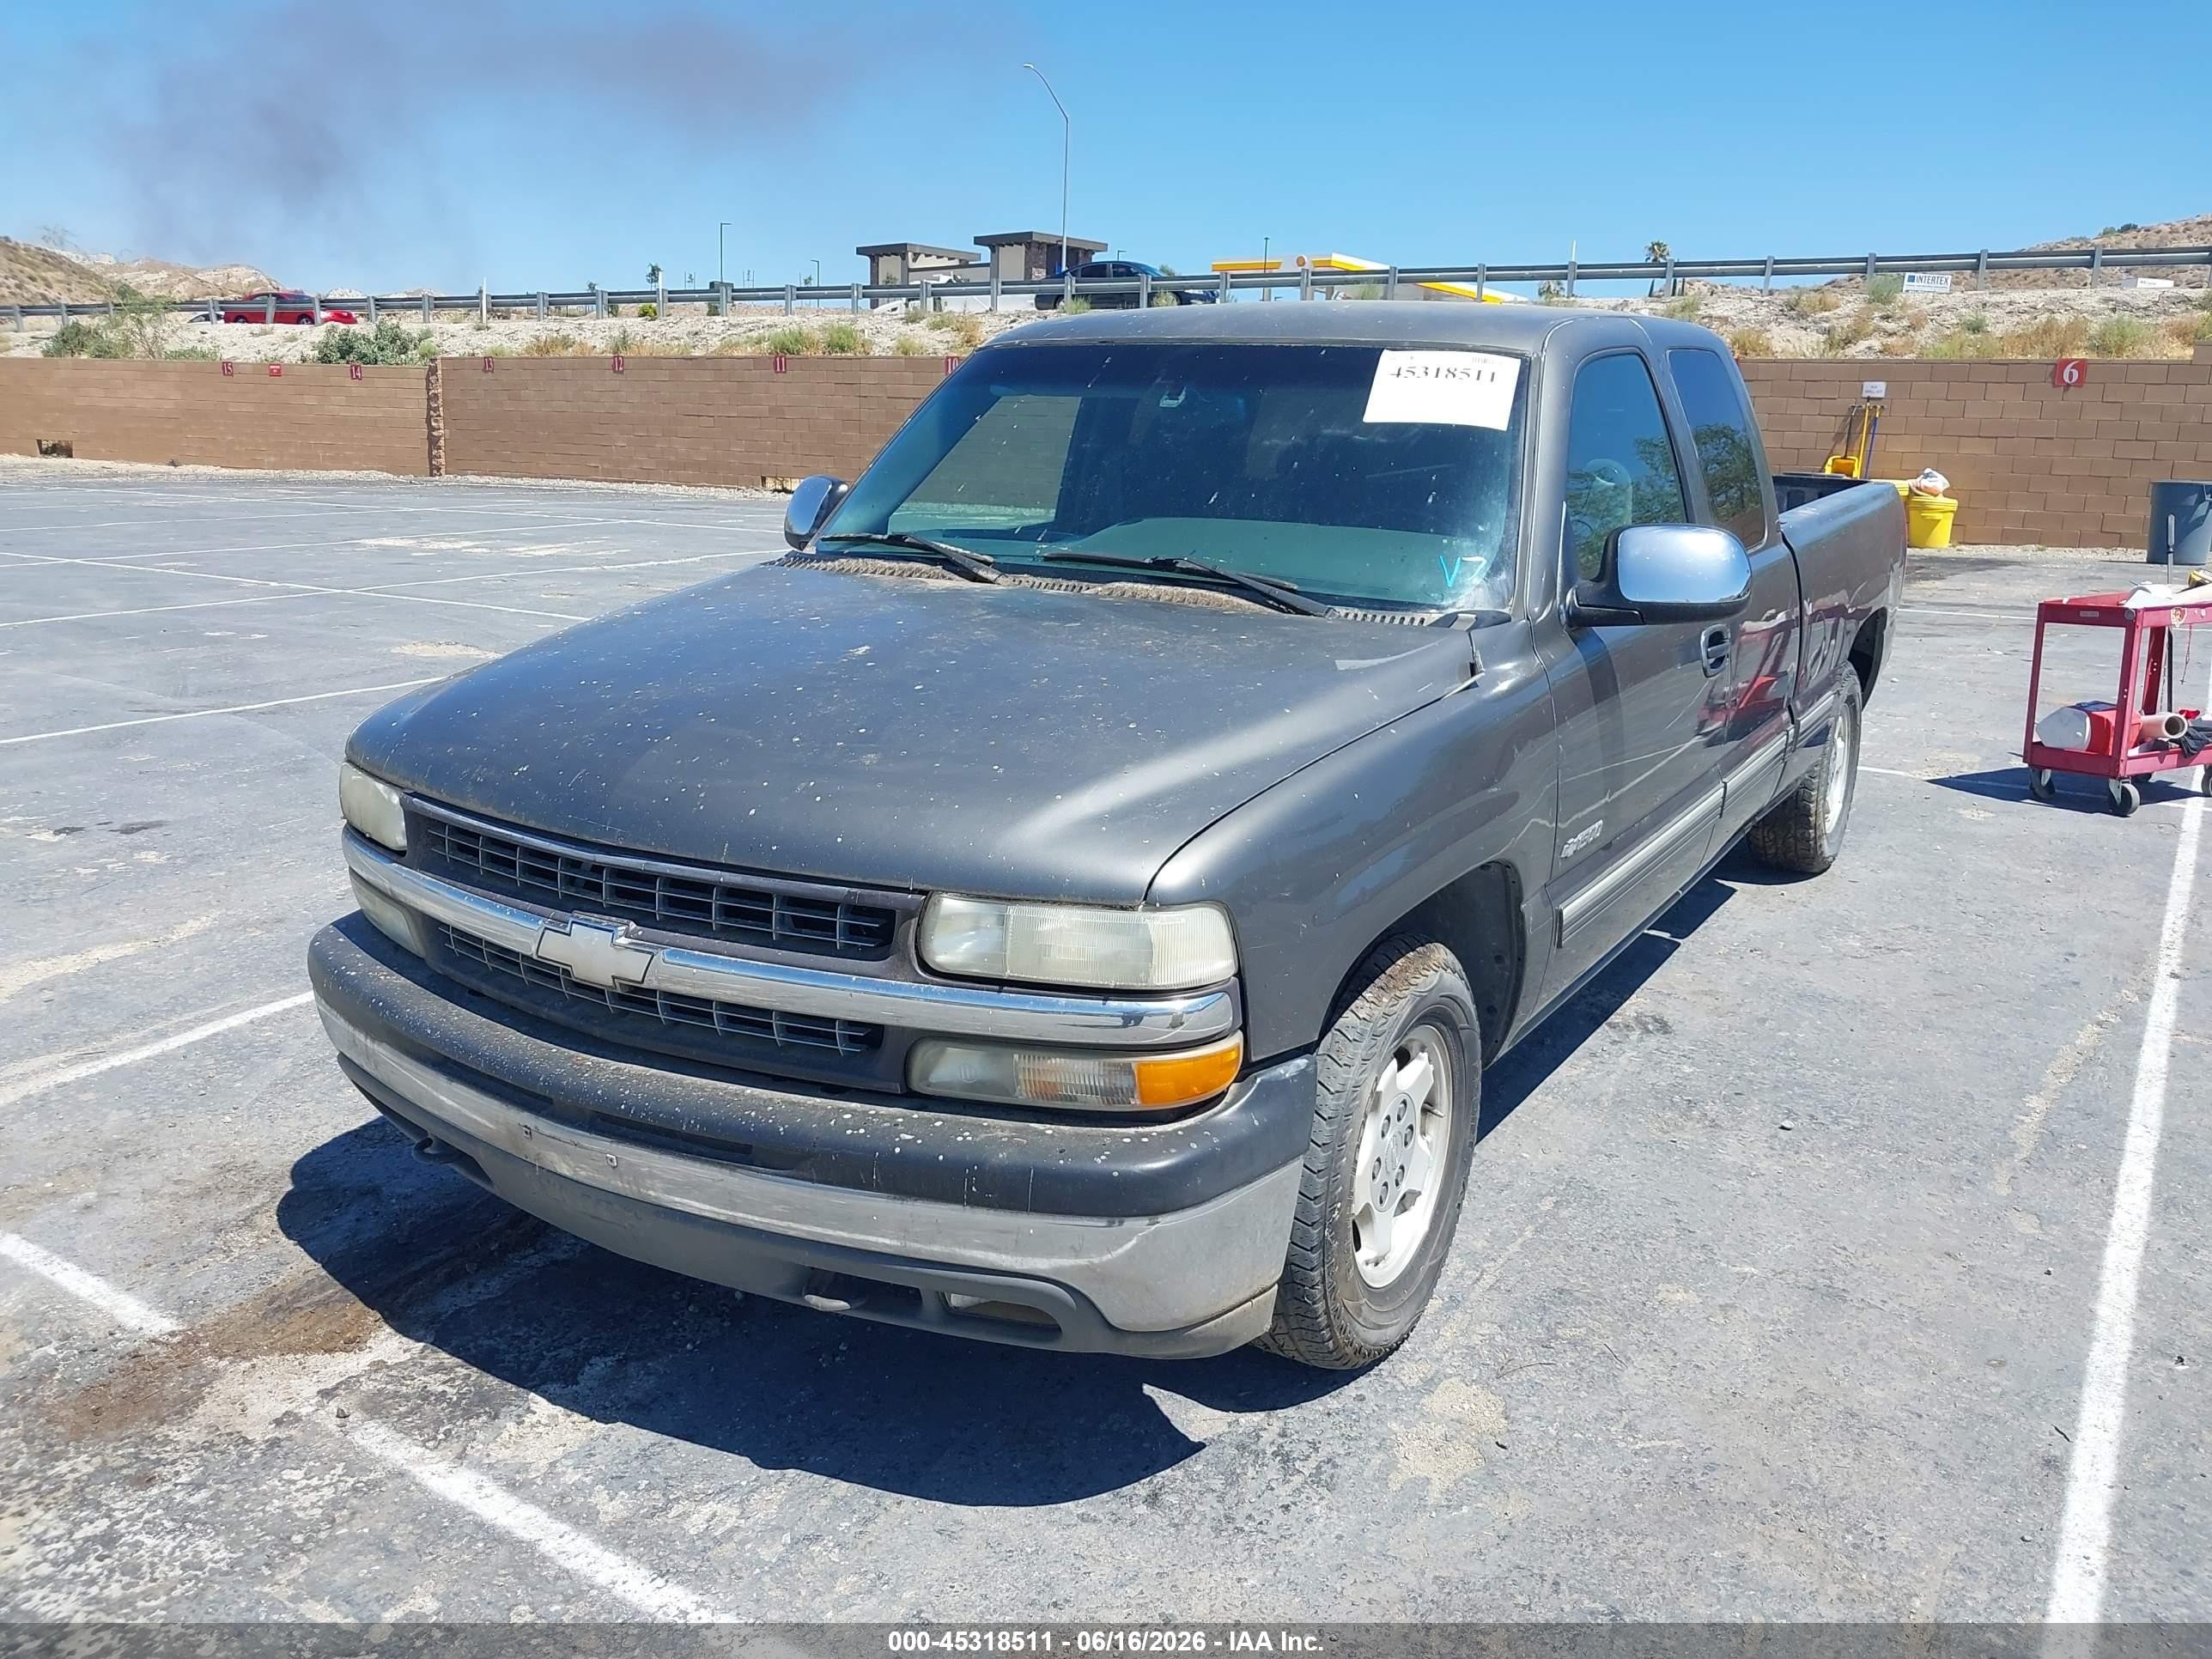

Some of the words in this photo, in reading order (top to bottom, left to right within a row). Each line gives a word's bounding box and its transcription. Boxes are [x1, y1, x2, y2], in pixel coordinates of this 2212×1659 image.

[1916, 275, 1949, 285] INTERTEX
[223, 362, 233, 375] 15
[484, 357, 494, 371] 13
[614, 357, 623, 371] 12
[775, 356, 786, 372] 11
[352, 366, 362, 379] 14
[1389, 366, 1496, 383] 45318511
[2063, 360, 2080, 385] 6
